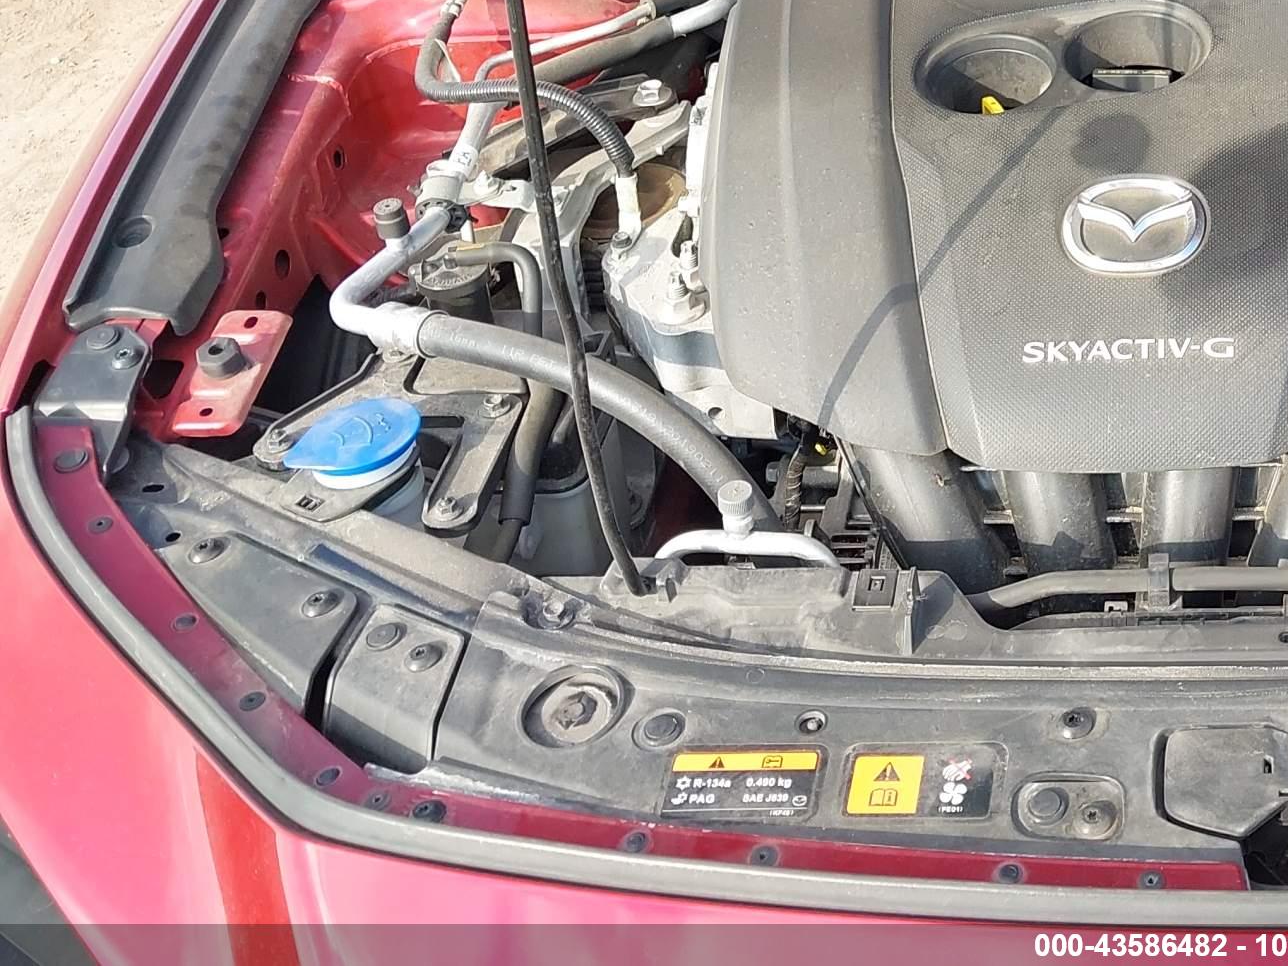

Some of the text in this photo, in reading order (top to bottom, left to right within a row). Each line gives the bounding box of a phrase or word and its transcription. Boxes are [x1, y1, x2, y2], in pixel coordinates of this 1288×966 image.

[1022, 337, 1235, 363] SKYACTIV-G
[693, 777, 732, 788] R-134a
[777, 776, 793, 789] kg
[688, 793, 716, 804] PAG
